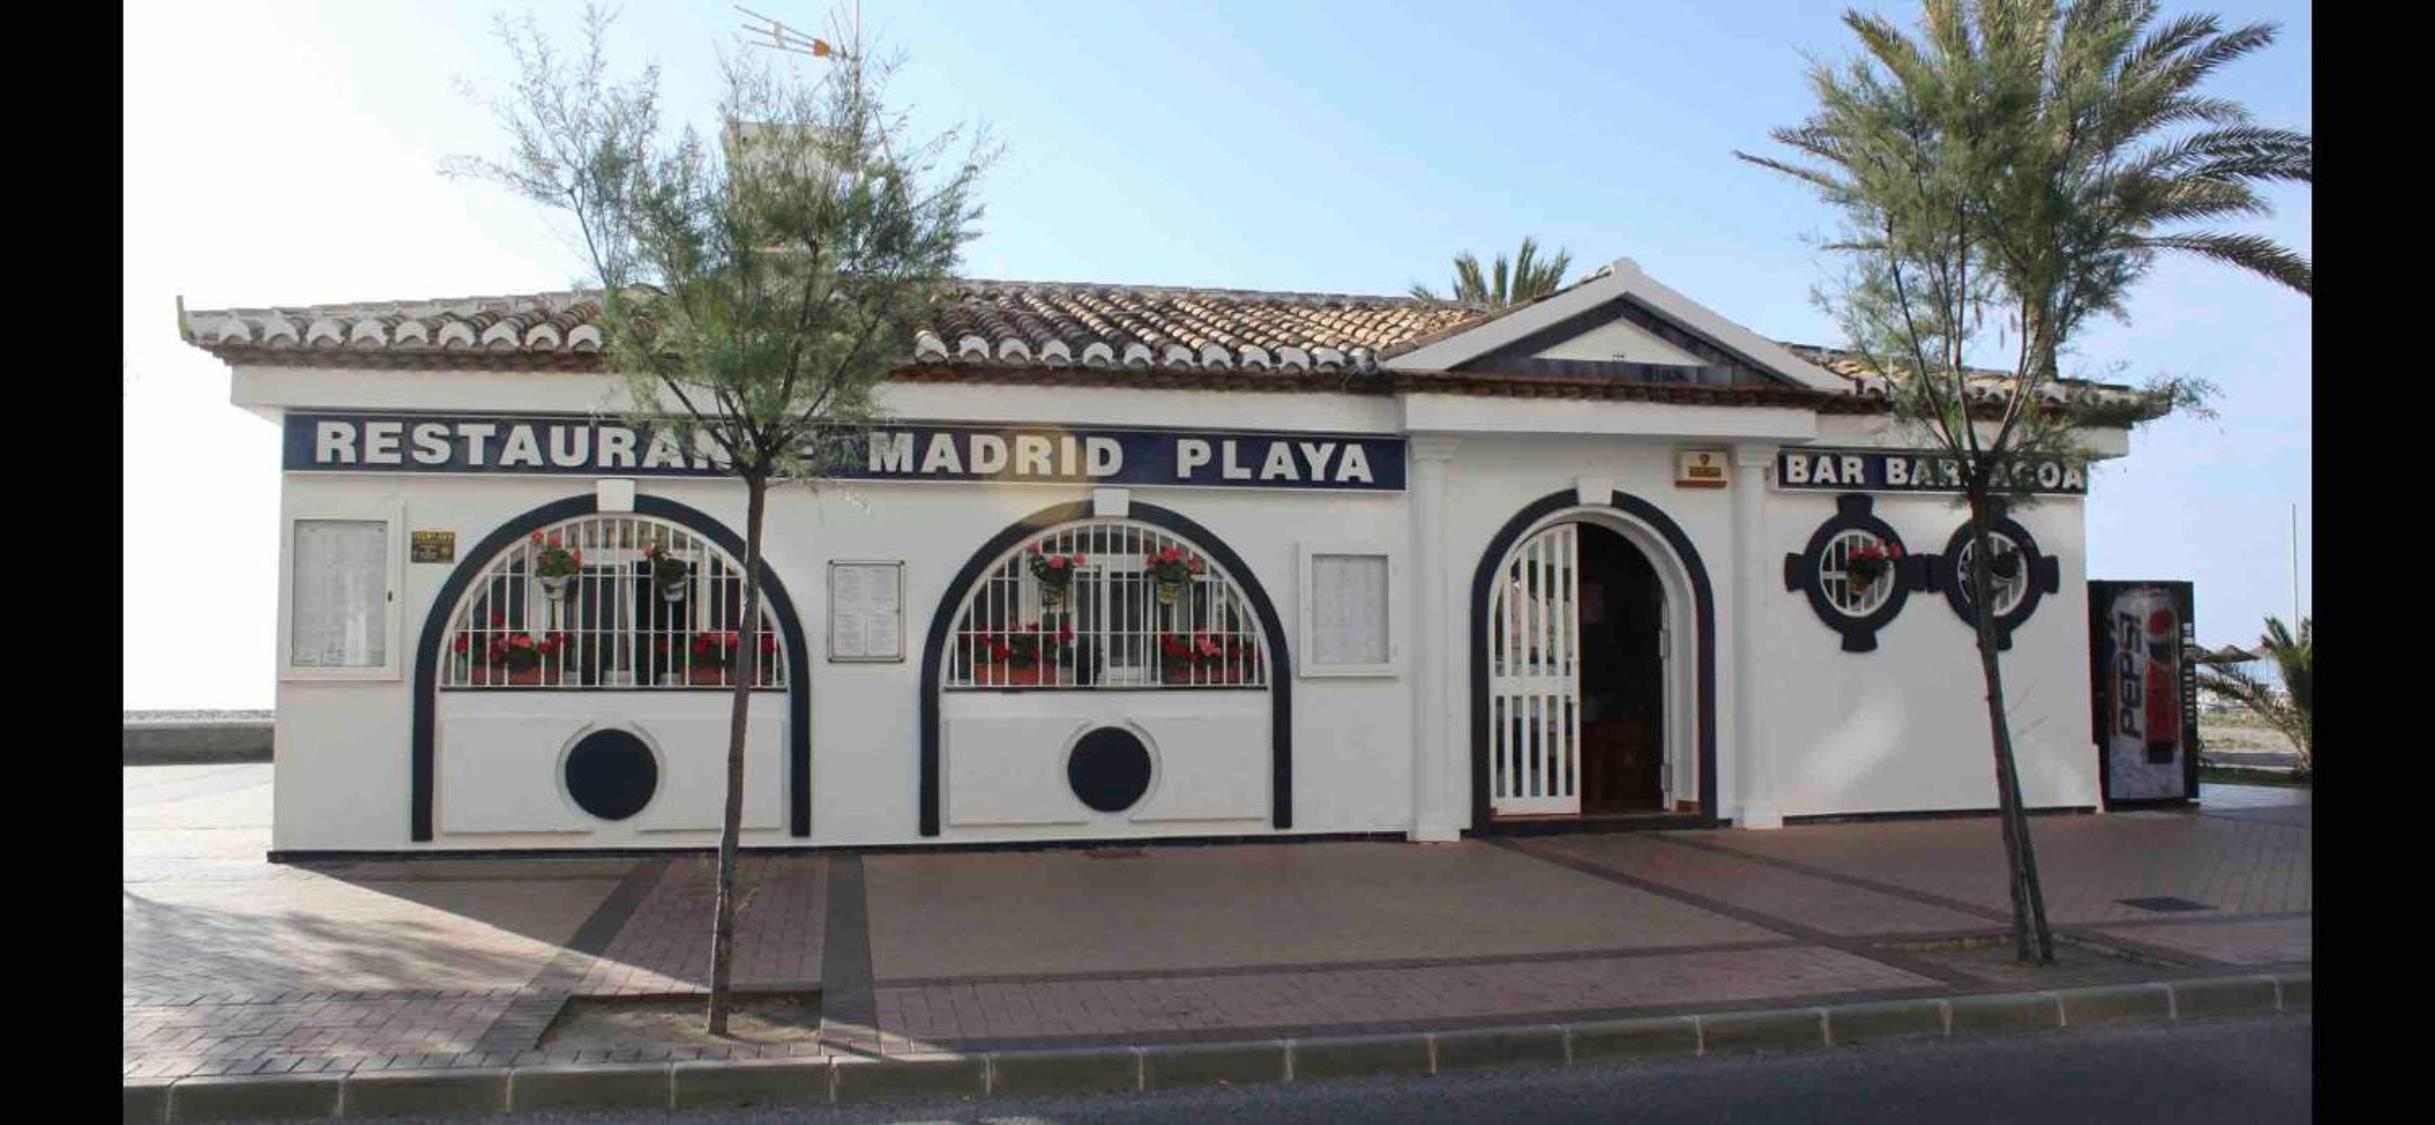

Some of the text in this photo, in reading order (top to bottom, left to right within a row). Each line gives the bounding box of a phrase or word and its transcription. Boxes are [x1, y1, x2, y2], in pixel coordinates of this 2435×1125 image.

[868, 431, 1124, 477] MADRID
[1177, 439, 1374, 483] PLAYA
[1786, 454, 1865, 485] BAR
[2119, 611, 2143, 739] PEPSI
